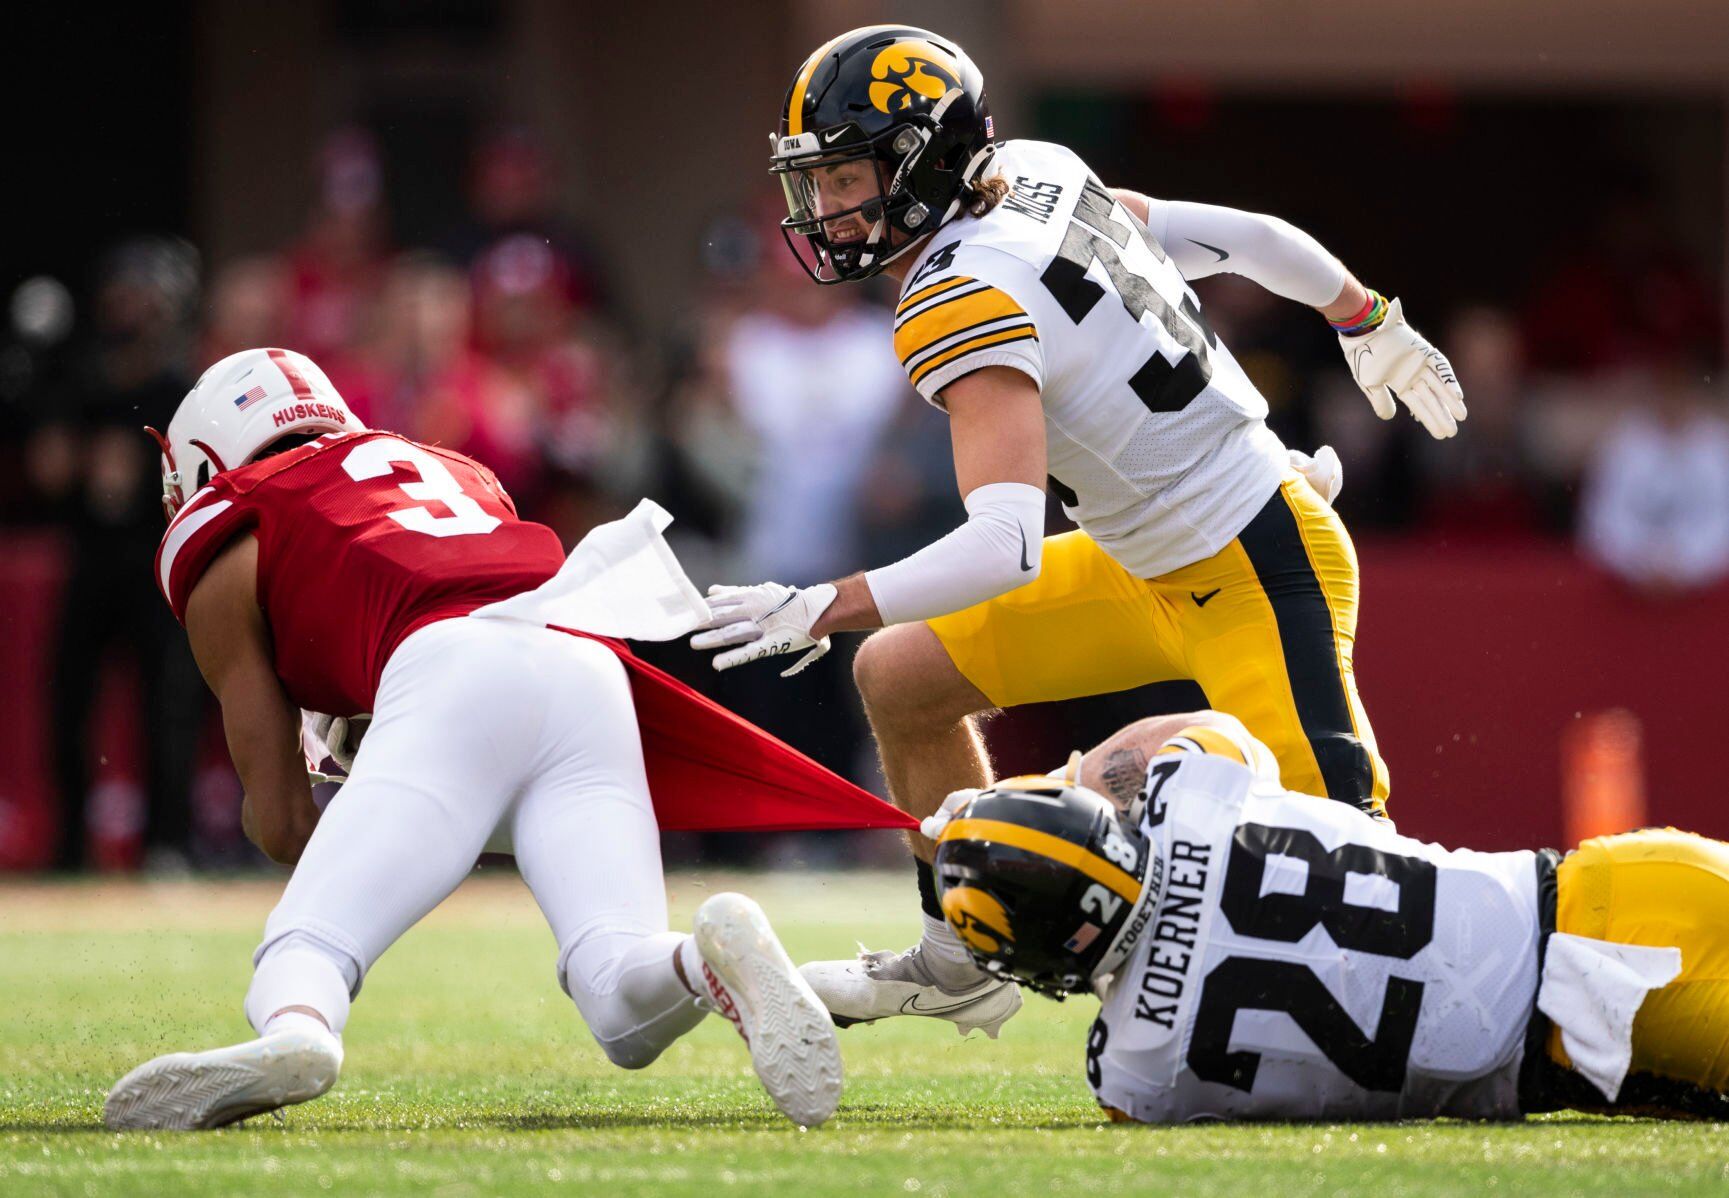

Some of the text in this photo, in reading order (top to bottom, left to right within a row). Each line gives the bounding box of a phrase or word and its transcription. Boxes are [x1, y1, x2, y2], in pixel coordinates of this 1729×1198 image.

[1001, 176, 1063, 225] MOSS
[272, 403, 346, 428] HUSKERS
[341, 437, 502, 537] 3
[1114, 855, 1164, 956] TOGETHER
[1135, 840, 1211, 1030] KOERNER
[1186, 822, 1438, 1093] 28
